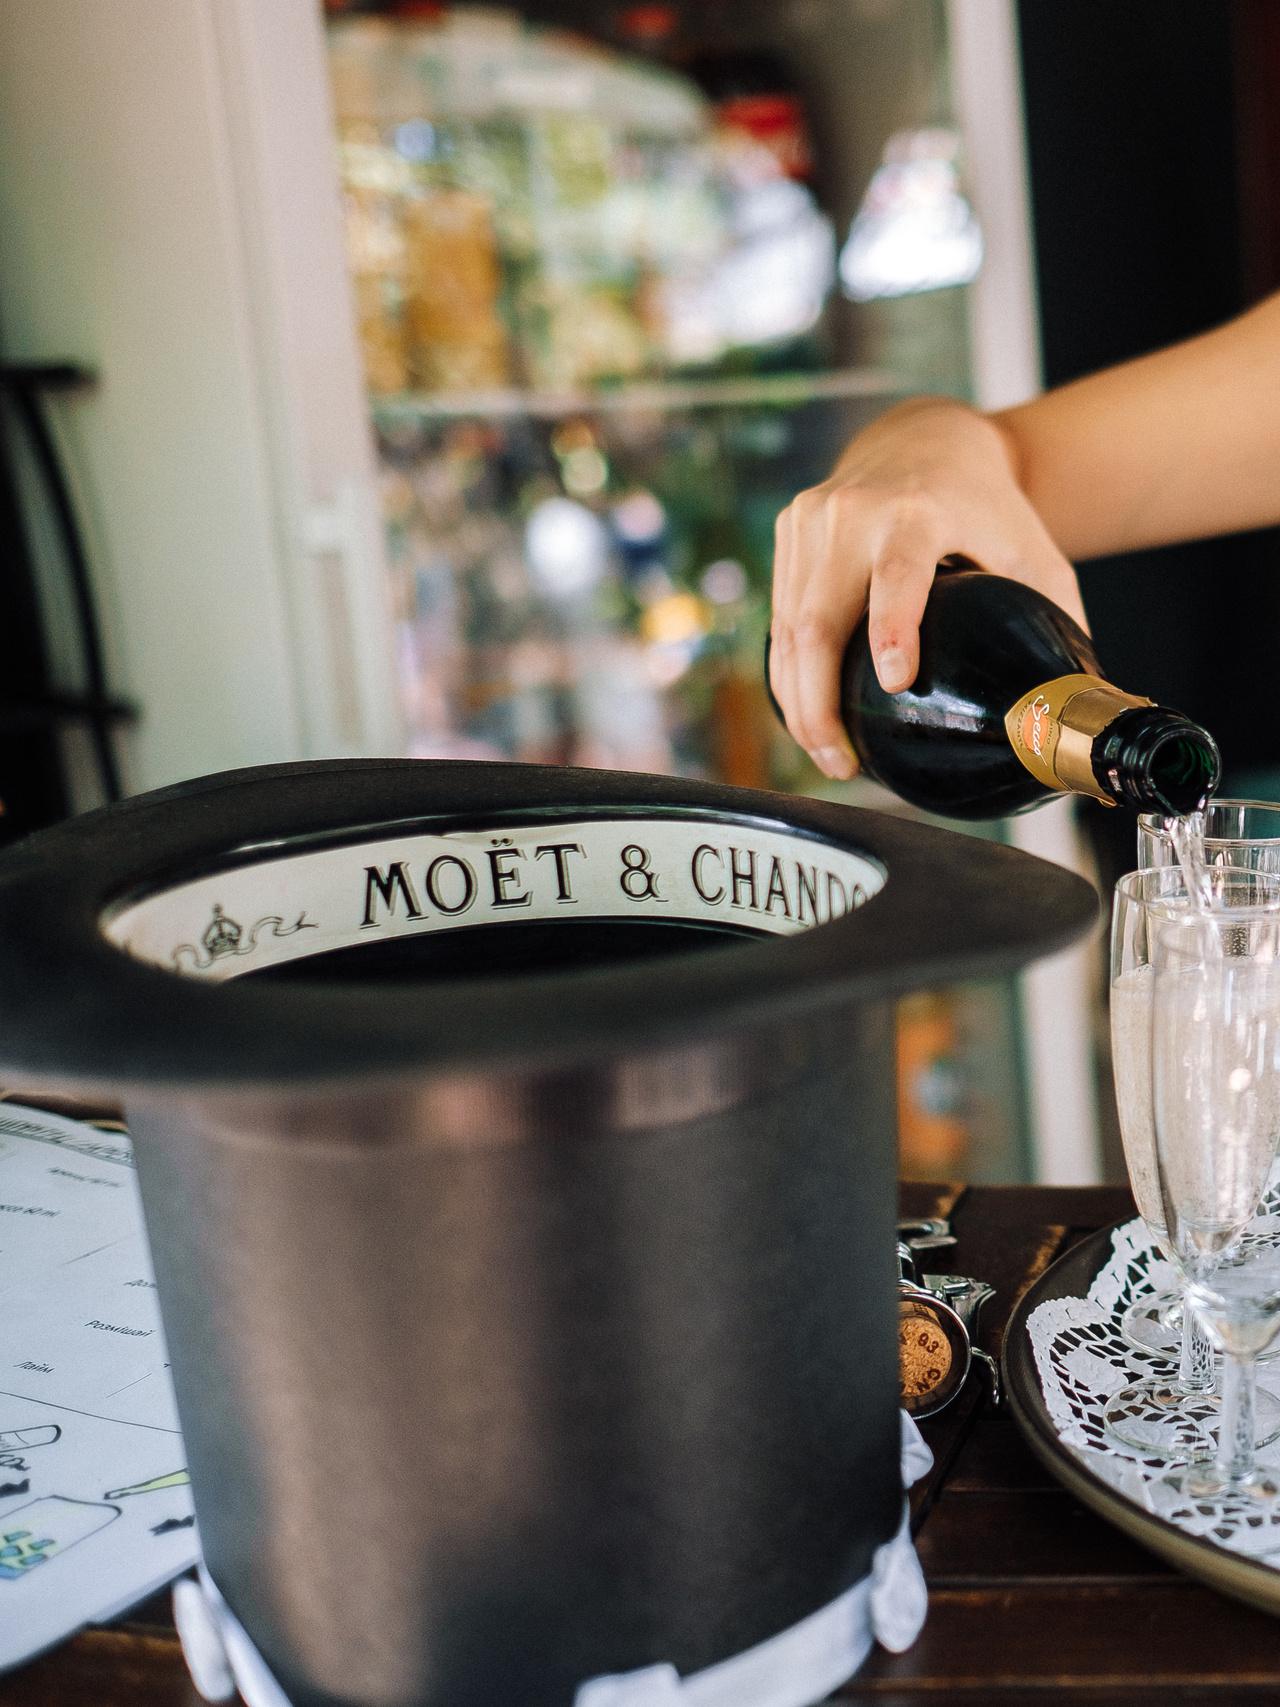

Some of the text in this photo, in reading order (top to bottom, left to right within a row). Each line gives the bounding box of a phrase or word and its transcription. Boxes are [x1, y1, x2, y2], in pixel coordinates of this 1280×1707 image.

[1032, 694, 1050, 767] Secco
[358, 838, 588, 928] MOËT
[619, 843, 669, 905] &
[13, 1360, 55, 1375] Лайм
